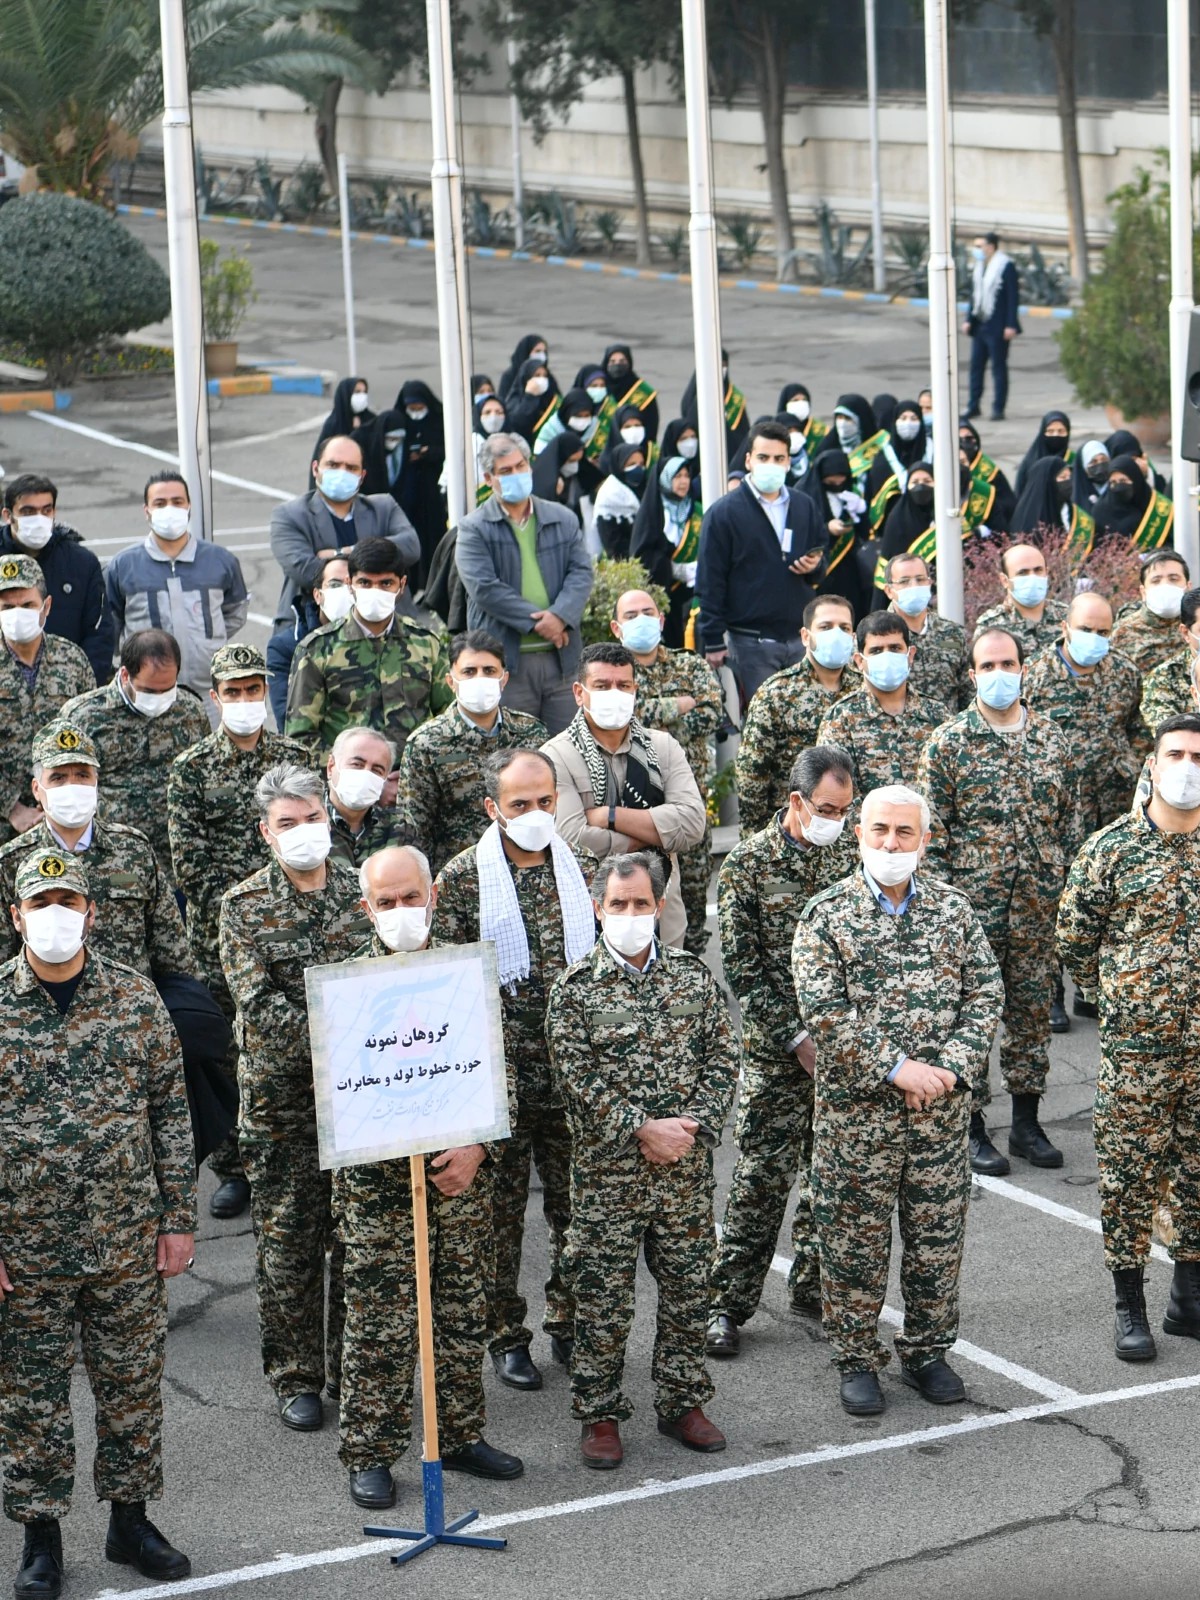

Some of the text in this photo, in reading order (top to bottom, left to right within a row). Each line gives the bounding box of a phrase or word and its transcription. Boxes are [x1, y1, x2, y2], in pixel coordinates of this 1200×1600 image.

[364, 1023, 449, 1052] گروهان نمونه
[336, 1059, 482, 1092] حوزه خطوط لوله و مخابرات
